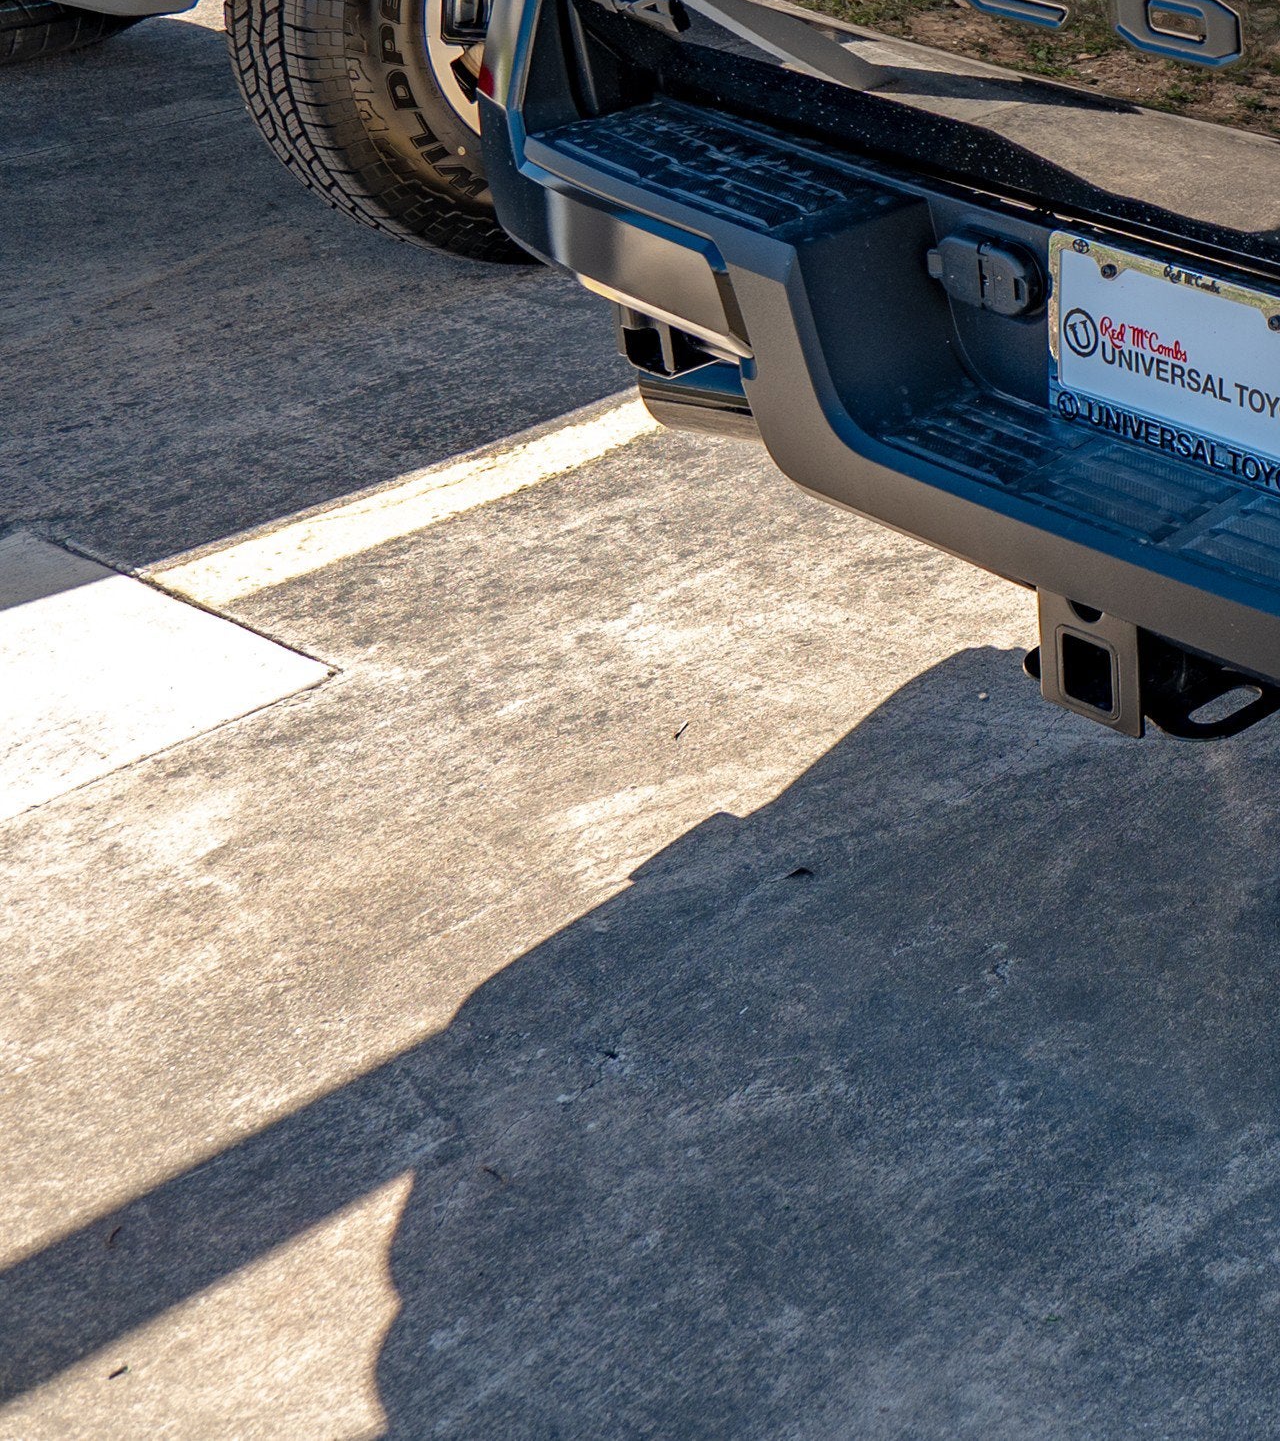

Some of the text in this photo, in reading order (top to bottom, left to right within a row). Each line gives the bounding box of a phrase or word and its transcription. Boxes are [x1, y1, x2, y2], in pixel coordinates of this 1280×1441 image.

[1100, 315, 1188, 362] Red McCombs
[1101, 341, 1232, 404] UNIVERSAL
[1087, 400, 1226, 469] UNIVERSAL
